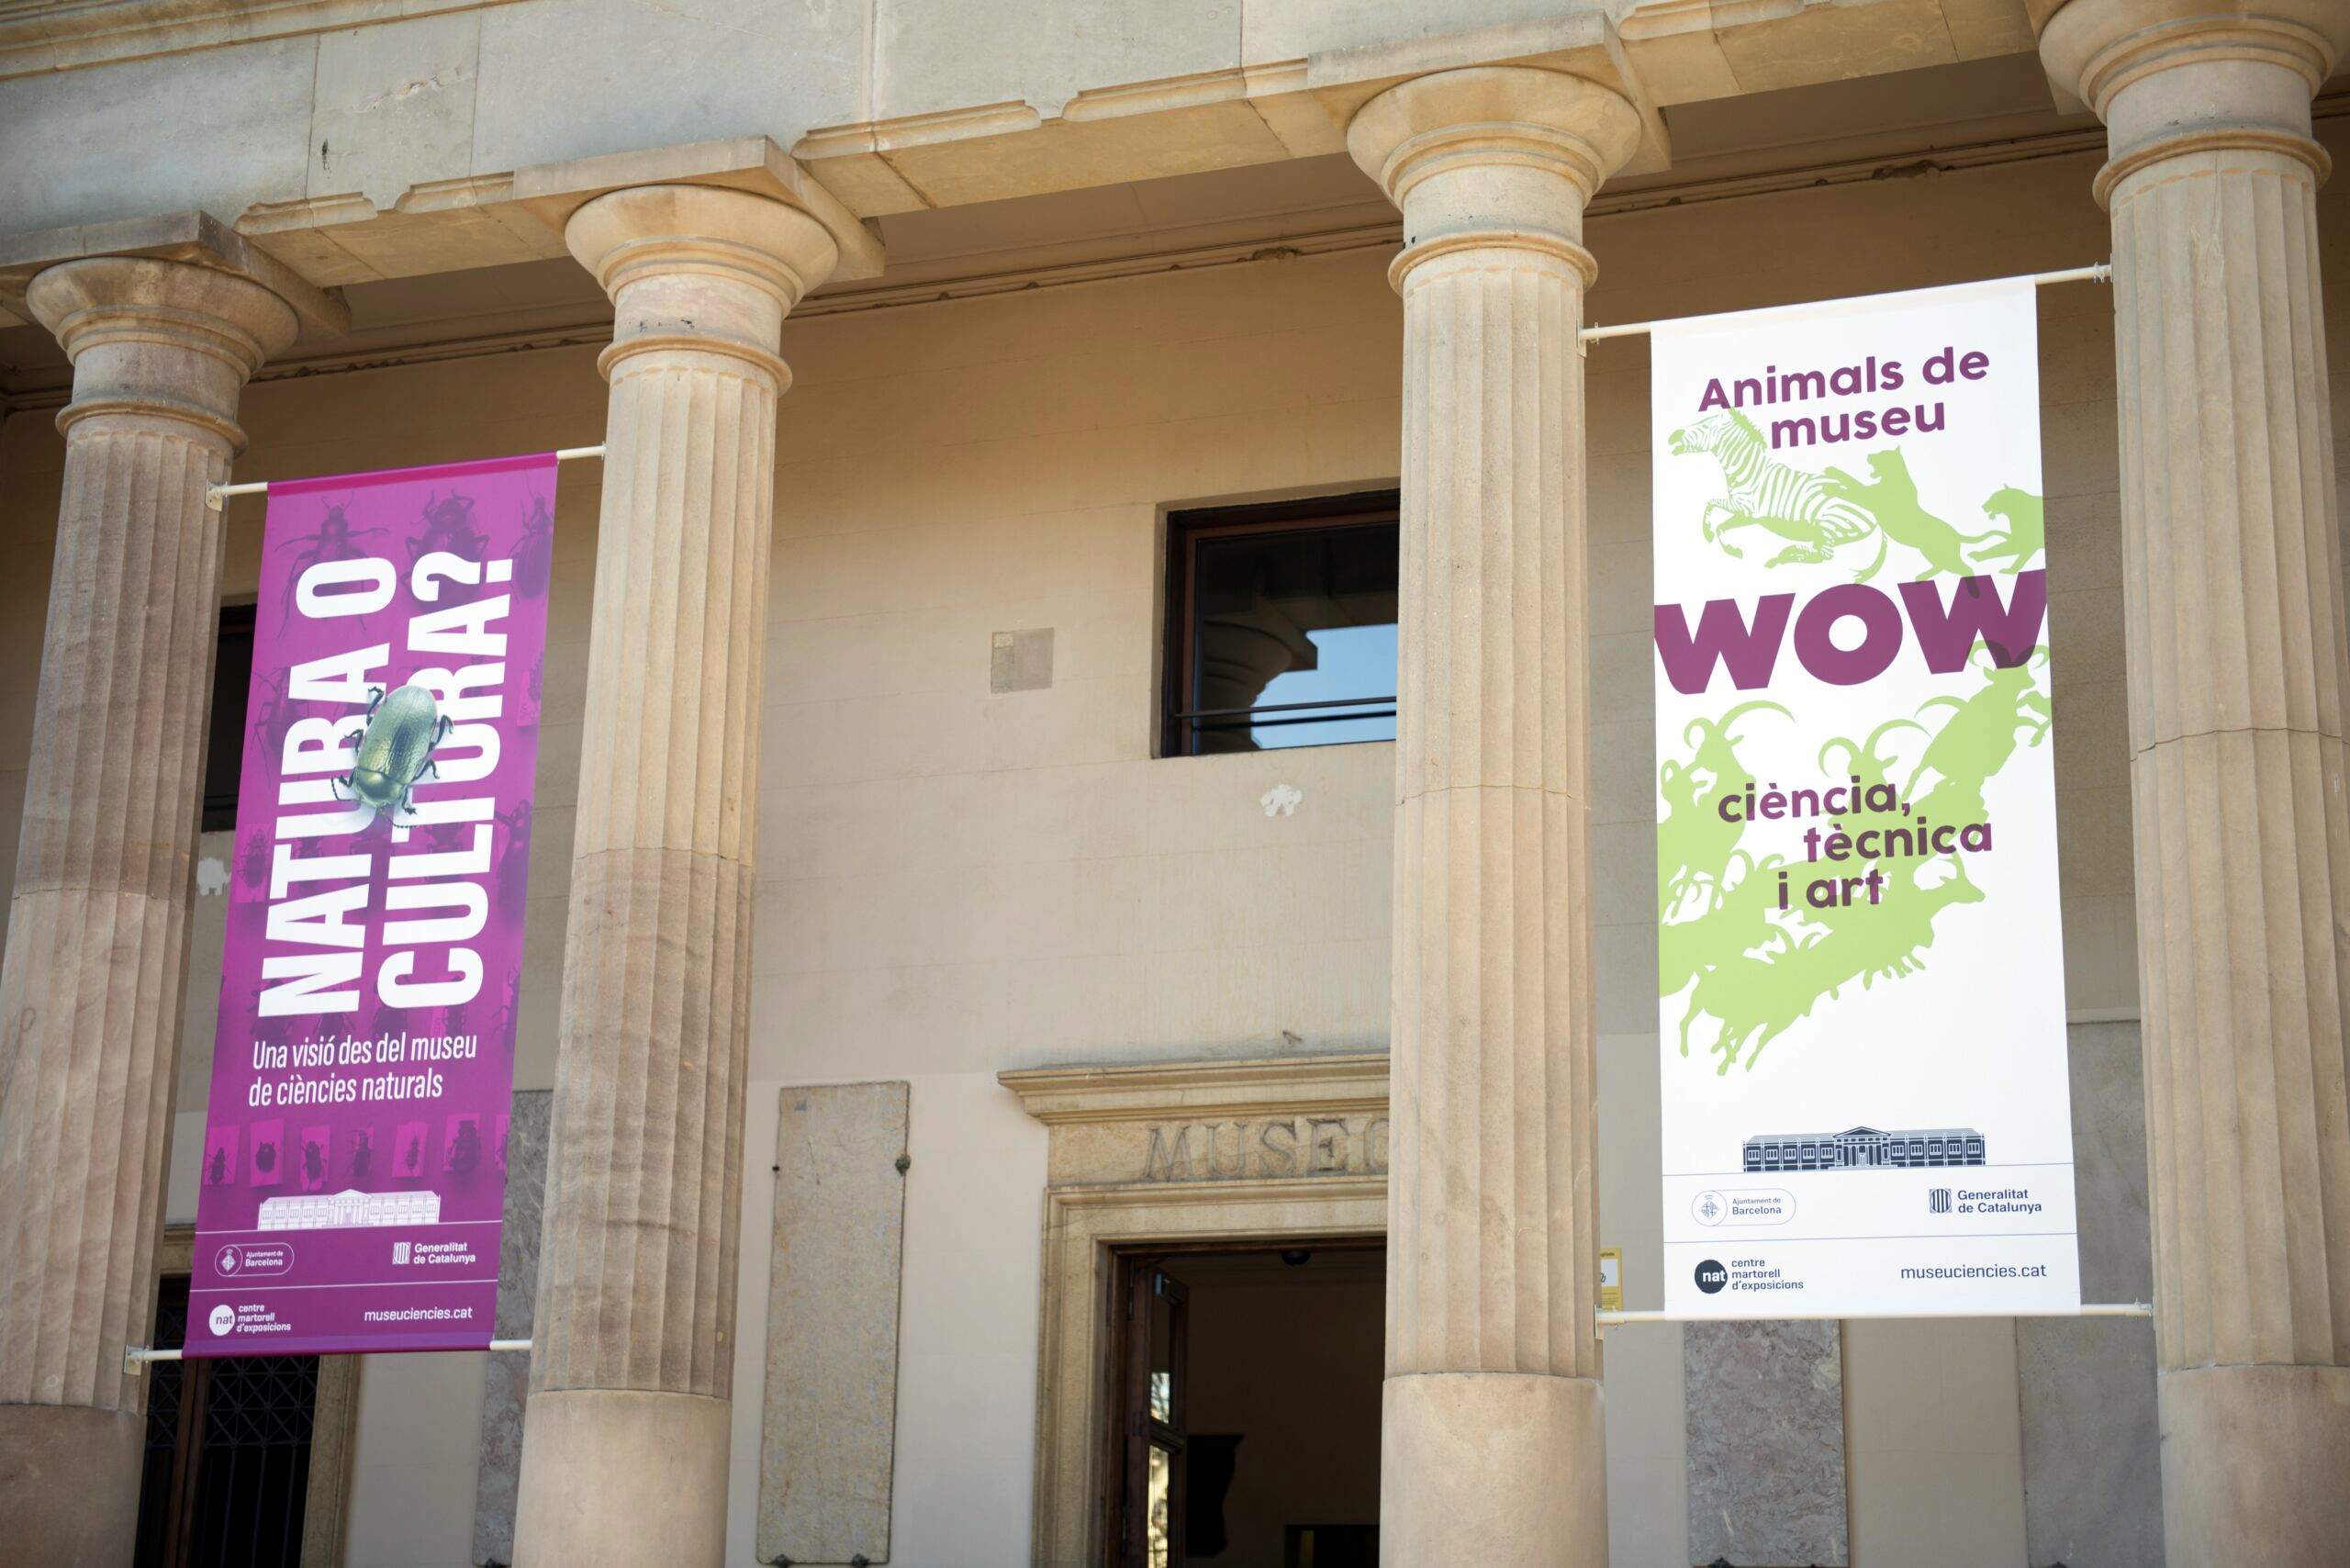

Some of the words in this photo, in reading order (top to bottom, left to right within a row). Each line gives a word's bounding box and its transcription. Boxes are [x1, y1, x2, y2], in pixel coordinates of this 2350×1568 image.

[1697, 356, 1906, 412] Animals
[1922, 346, 1990, 386] de
[1770, 401, 1945, 450] museu
[296, 556, 397, 619] O
[1654, 568, 2047, 695] WOW
[377, 551, 512, 1009] CULTURA?
[1718, 775, 1910, 823] ciència,
[258, 643, 390, 1017] NATURA
[1803, 816, 1992, 863] tècnica
[1778, 871, 1788, 910] i
[1806, 868, 1884, 909] art
[252, 1040, 287, 1070] Una
[292, 1035, 335, 1068] visió
[338, 1034, 372, 1066] des
[375, 1031, 407, 1064] del
[410, 1034, 477, 1062] museu
[249, 1076, 273, 1107] de
[276, 1071, 357, 1105] ciències
[362, 1067, 443, 1102] naturals
[1957, 1189, 2029, 1200] Generalitat
[1732, 1205, 1782, 1215] Barcelona
[1958, 1203, 1974, 1213] de
[1977, 1202, 2042, 1214] Catalunya
[414, 1242, 467, 1253] Generalitat
[245, 1259, 283, 1267] Barcelona
[413, 1255, 426, 1264] de
[428, 1253, 476, 1265] Catalunya
[1731, 1259, 1765, 1267] centre
[1702, 1270, 1727, 1282] nat
[1731, 1269, 1781, 1279] martorell
[1901, 1264, 2047, 1279] museuciencies.cat
[215, 1315, 234, 1325] nat
[238, 1313, 275, 1322] martorell
[364, 1306, 473, 1321] museuciencies.cat
